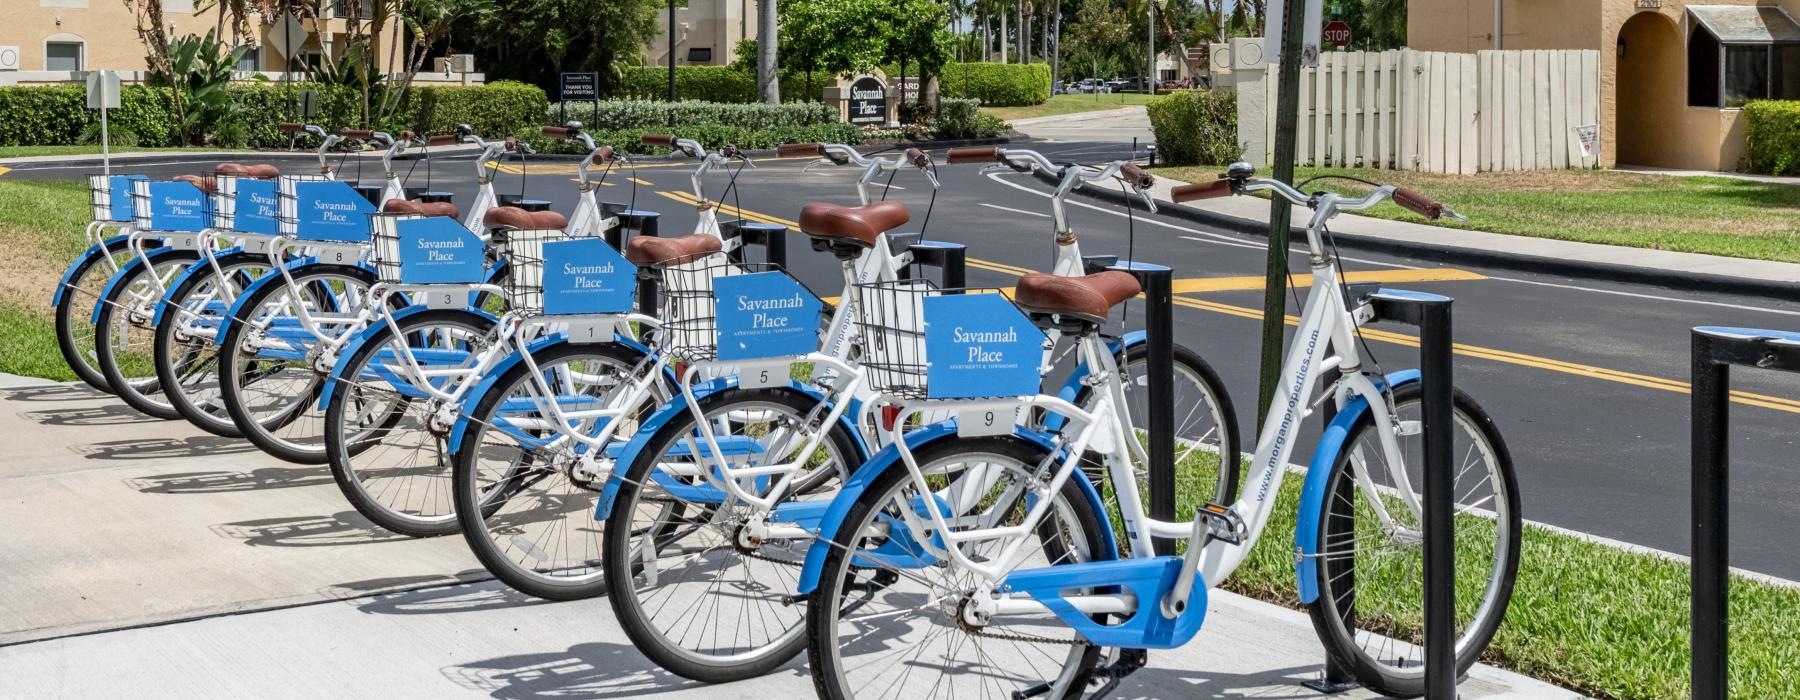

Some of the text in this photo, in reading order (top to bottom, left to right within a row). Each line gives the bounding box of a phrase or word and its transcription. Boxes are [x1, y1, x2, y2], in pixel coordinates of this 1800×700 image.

[1324, 30, 1350, 41] STOP
[852, 86, 884, 100] Savannah
[859, 101, 877, 114] Place
[164, 197, 201, 207] Savannah
[314, 200, 357, 211] Savannah
[172, 206, 192, 215] Place
[323, 212, 347, 222] Place
[185, 238, 191, 247] 6
[260, 241, 265, 250] 7
[417, 237, 465, 249] Savannah
[336, 252, 342, 262] 8
[428, 250, 454, 261] Place
[563, 262, 614, 275] Savannah
[574, 276, 602, 289] Place
[444, 294, 452, 305] 3
[737, 293, 803, 312] Savannah
[752, 313, 788, 329] Place
[588, 327, 594, 338] 1
[953, 326, 1017, 343] Savannah
[967, 346, 1003, 363] Place
[759, 370, 768, 384] 5
[985, 411, 994, 426] 9
[1256, 329, 1320, 502] www.morganproperties.com
